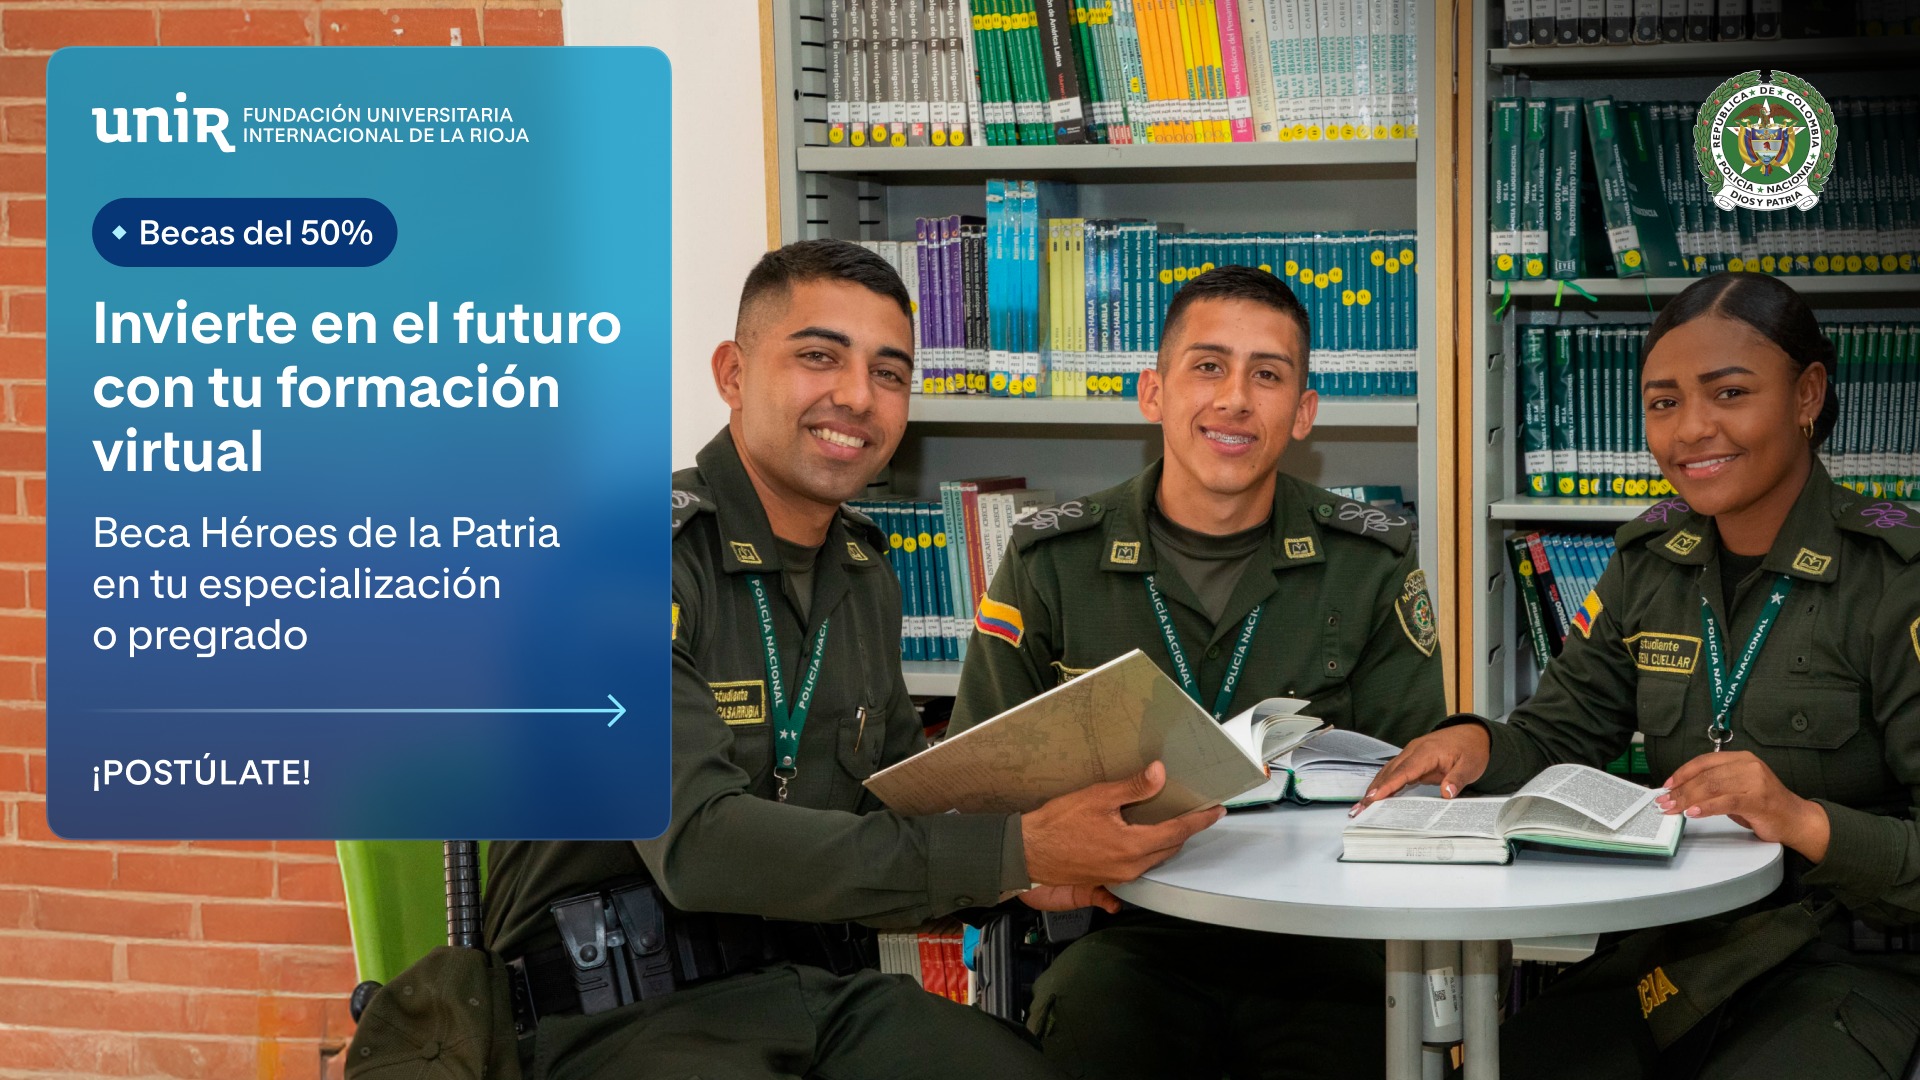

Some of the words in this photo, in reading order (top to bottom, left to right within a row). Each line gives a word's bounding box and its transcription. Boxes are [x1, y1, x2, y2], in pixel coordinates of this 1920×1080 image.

[1046, 0, 1054, 8] ón
[1048, 9, 1055, 18] de
[1224, 0, 1234, 31] Pensami
[833, 29, 840, 39] de
[852, 27, 860, 38] de
[853, 40, 860, 48] la
[949, 26, 957, 36] de
[950, 38, 958, 47] la
[1049, 18, 1058, 46] América
[1228, 33, 1236, 44] del
[833, 41, 841, 50] la
[1054, 46, 1062, 67] Latina
[1270, 40, 1281, 76] URBANIDAD
[1279, 39, 1287, 75] MANERAS
[1286, 39, 1296, 75] URBANIDAD
[1294, 38, 1302, 74] MANERAS
[1230, 46, 1239, 72] Básicos
[1562, 184, 1568, 196] DE
[1554, 192, 1562, 221] CÓDIGO
[1088, 300, 1096, 327] HABLA
[944, 492, 952, 534] AFECTIVIDAD
[948, 536, 954, 544] LA
[1530, 602, 1540, 628] libertad
[751, 579, 772, 634] POLICÍA
[766, 636, 784, 708] NACIONAL
[1163, 624, 1192, 688] NACIONAL
[1538, 634, 1547, 652] hacia
[1640, 638, 1680, 652] studiante
[1735, 617, 1769, 680] NACIONAL
[1224, 645, 1247, 693] POLICÍA
[1651, 654, 1691, 668] CUELLAR
[713, 689, 748, 702] studiante
[798, 658, 820, 710] POLICÍA
[1637, 966, 1679, 1019] CIA
